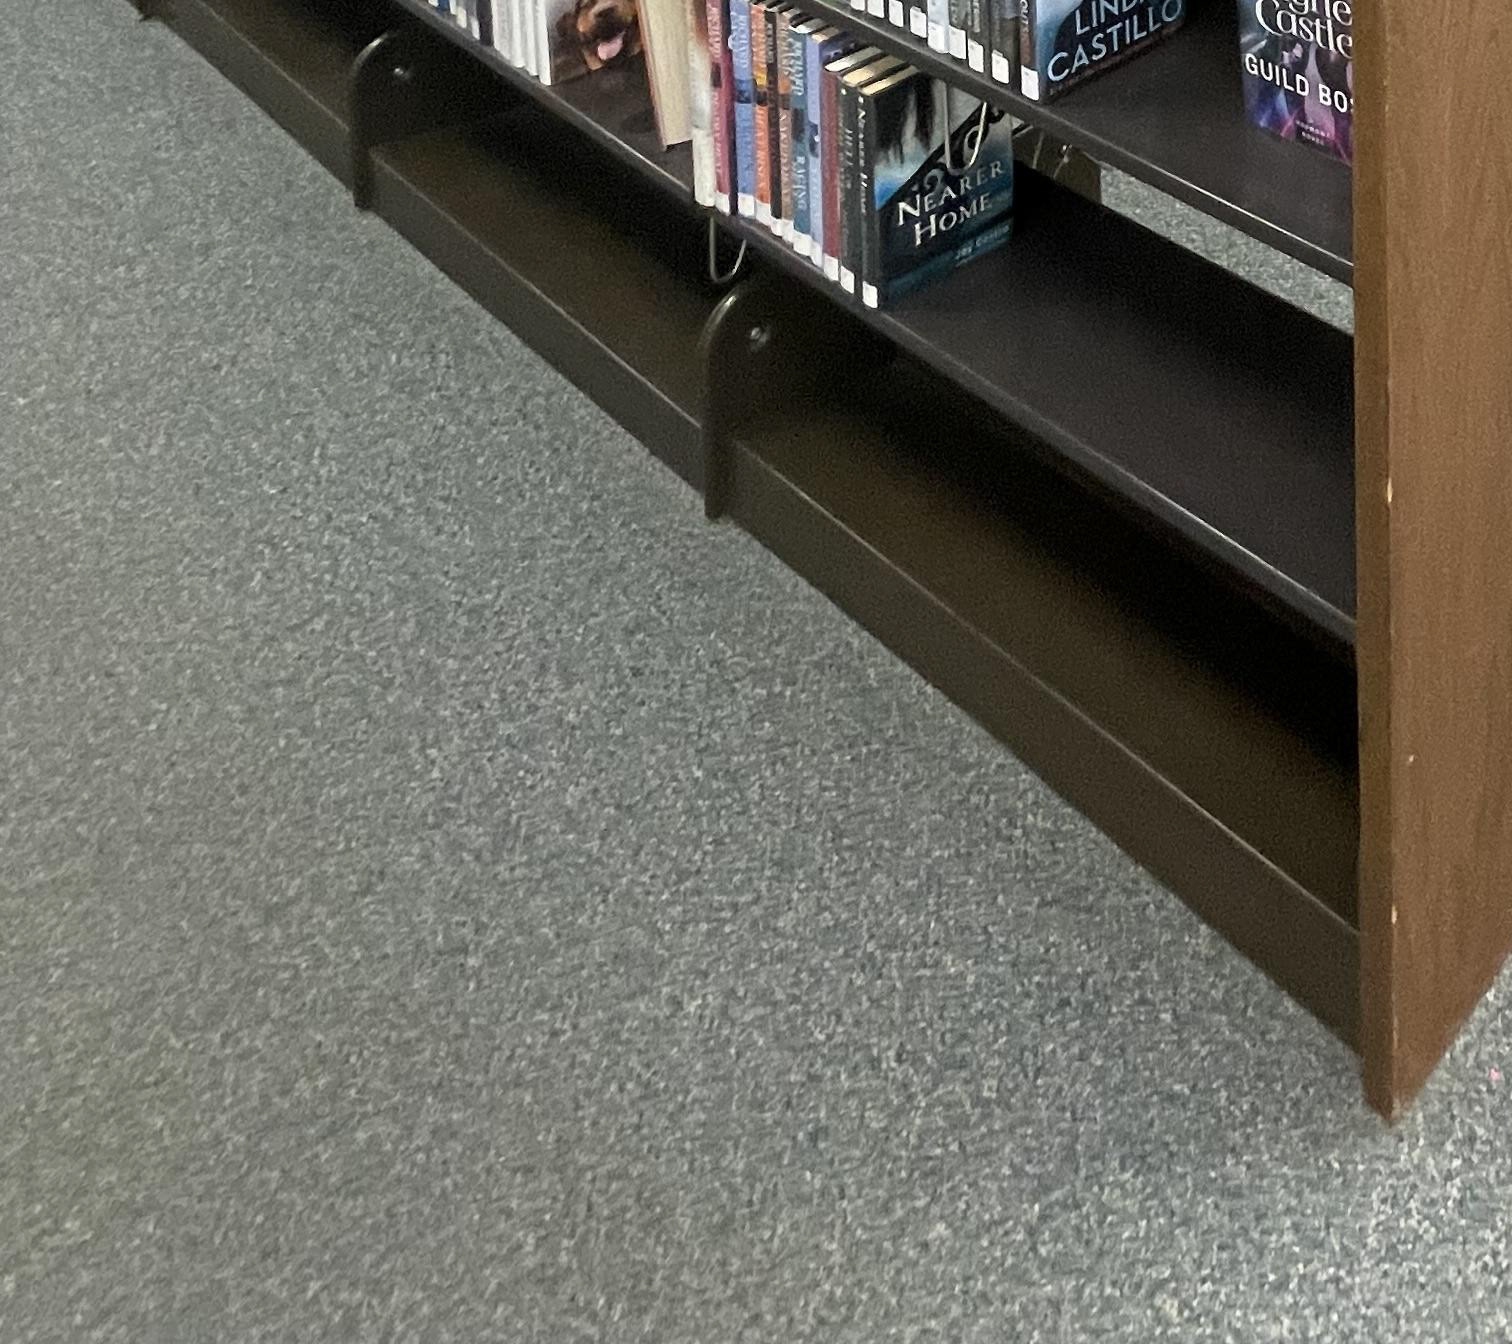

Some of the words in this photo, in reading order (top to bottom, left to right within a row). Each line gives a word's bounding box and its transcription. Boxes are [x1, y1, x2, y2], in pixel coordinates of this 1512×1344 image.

[792, 40, 804, 95] RICHARD
[1245, 52, 1310, 97] GUILD
[857, 107, 867, 168] NEARER
[795, 156, 807, 210] RAGING
[897, 160, 1003, 227] NEARER
[914, 192, 993, 248] HOME
